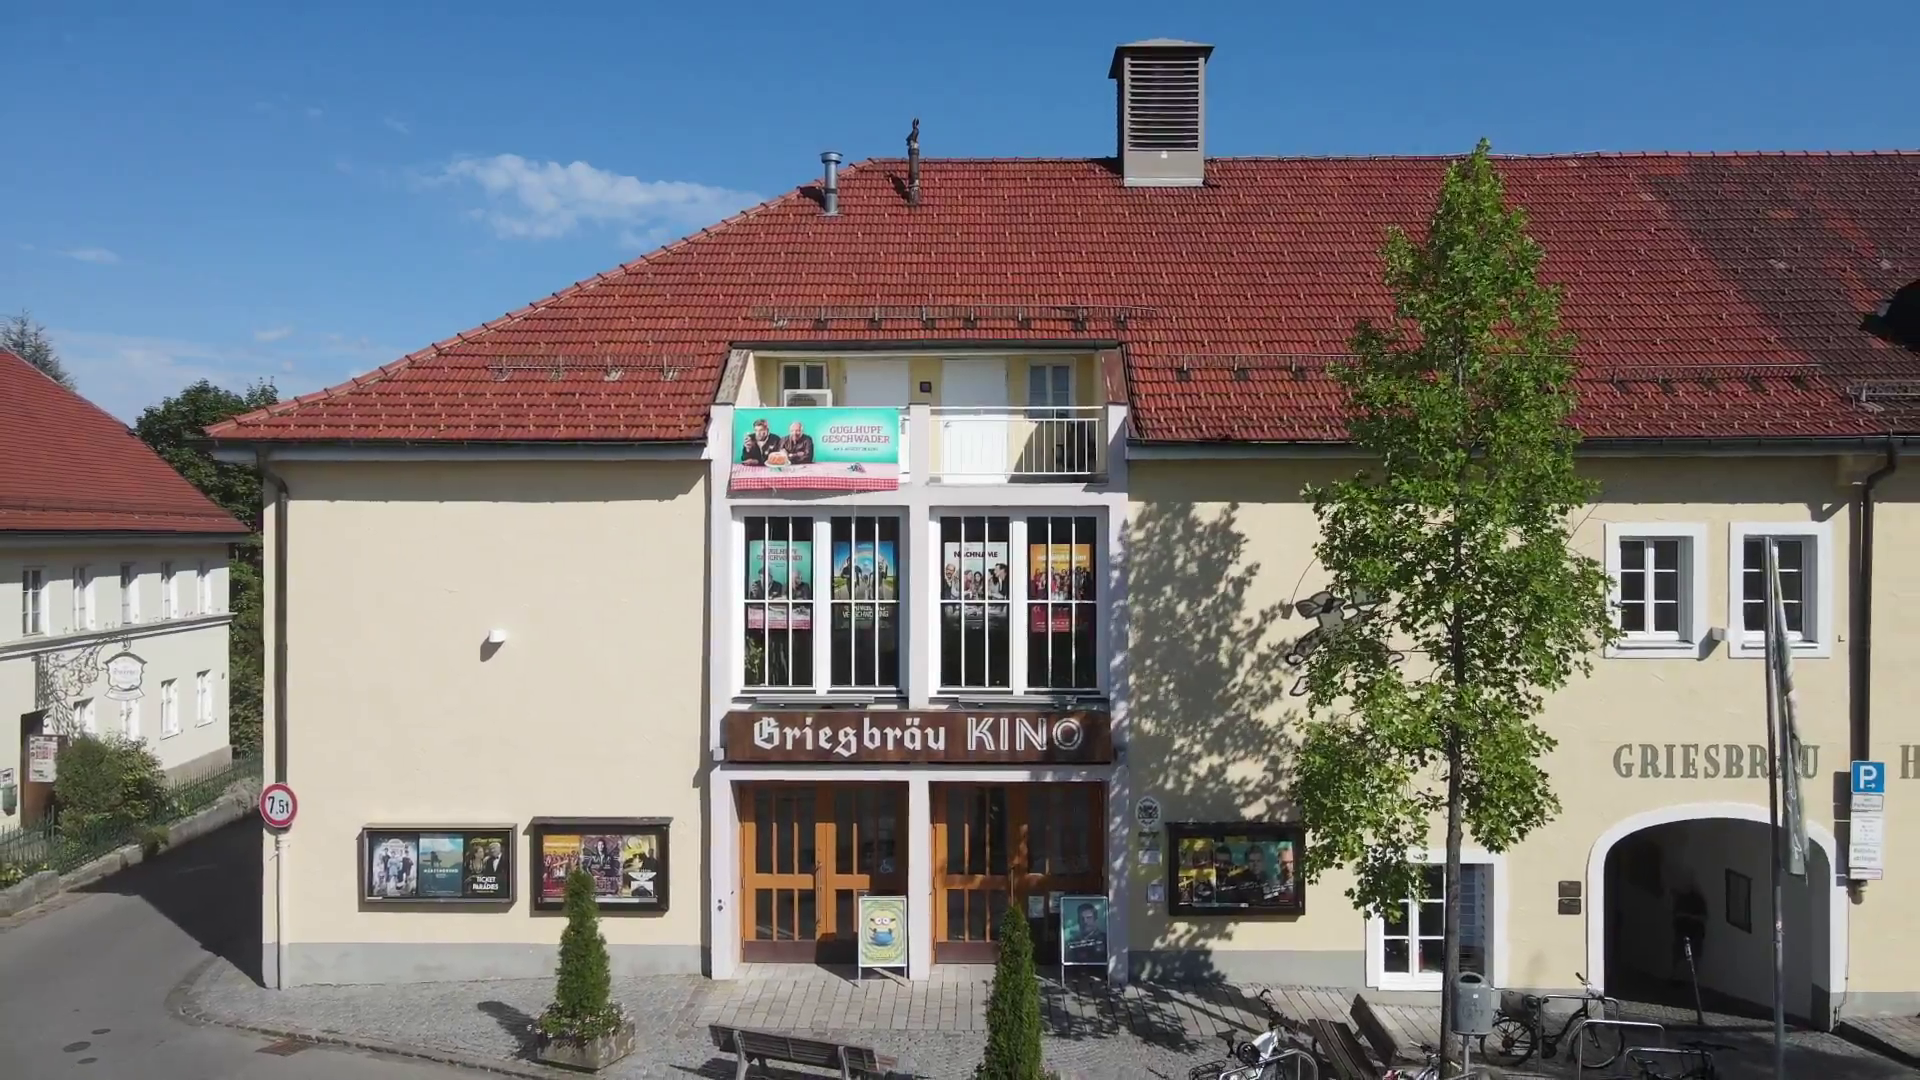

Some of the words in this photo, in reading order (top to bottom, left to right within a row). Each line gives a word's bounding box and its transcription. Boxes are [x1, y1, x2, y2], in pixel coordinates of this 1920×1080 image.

[821, 434, 890, 444] GESCHWADER
[829, 425, 884, 434] GUGLHUPF
[754, 716, 945, 757] Griesbräu
[967, 717, 1083, 751] KINO
[1613, 743, 1820, 779] GRIESBRU
[1859, 765, 1878, 790] P
